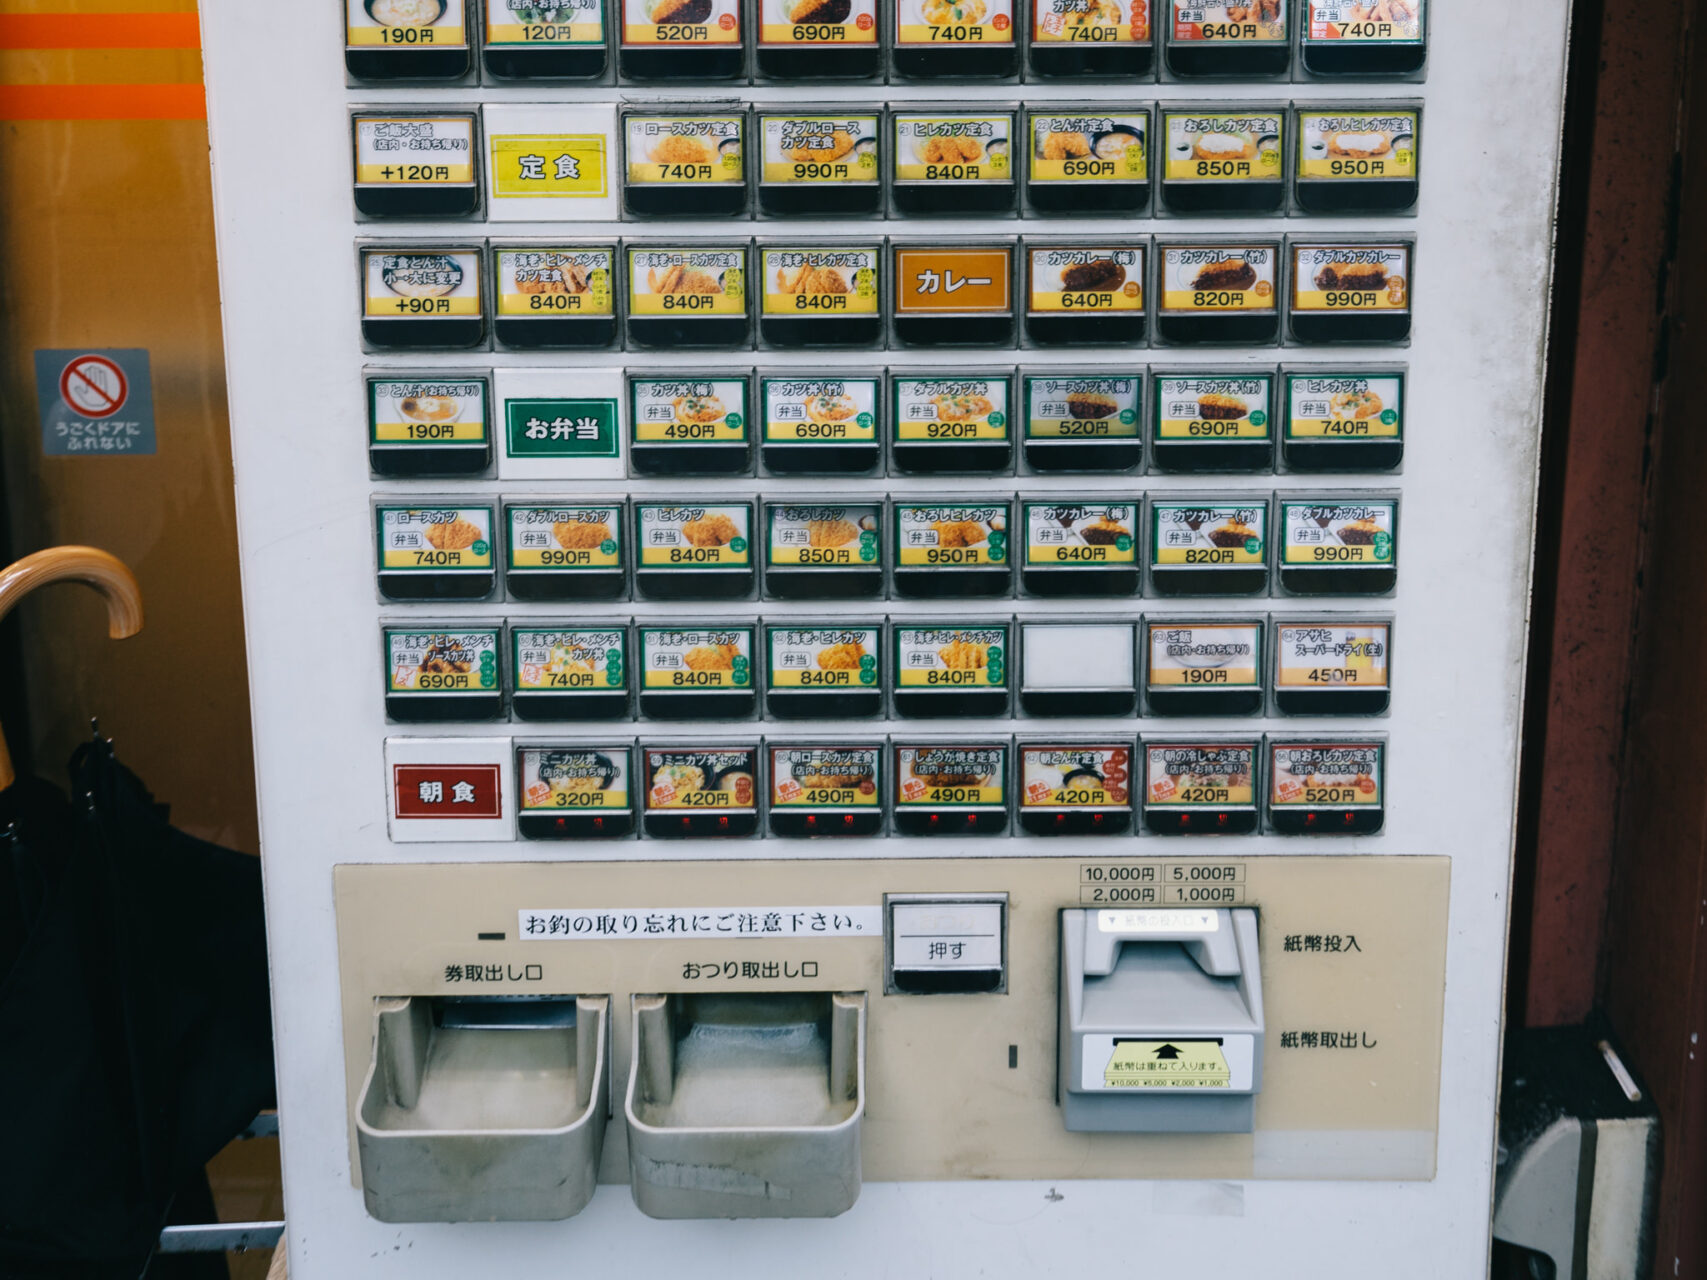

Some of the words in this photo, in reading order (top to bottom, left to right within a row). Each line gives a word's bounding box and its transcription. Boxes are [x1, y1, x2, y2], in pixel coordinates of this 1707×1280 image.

[1179, 11, 1204, 22] 弁当
[522, 26, 571, 40] 120円
[656, 26, 708, 40] 520円
[792, 27, 845, 40] 690円
[1070, 27, 1117, 41] 740円
[1202, 24, 1256, 38] 640円
[1338, 23, 1392, 38] 740円
[374, 123, 433, 138] ご飯大盛
[914, 123, 992, 137] ヒレカツ定食
[1051, 119, 1114, 132] とん汁定食
[1185, 119, 1279, 132] おろしカツ定食
[519, 154, 581, 180] 定食
[659, 164, 712, 179] 740円
[794, 164, 848, 178] 990円
[926, 165, 979, 180] 840円
[1197, 161, 1250, 176] 850円
[1331, 160, 1384, 175] 950円
[1314, 251, 1400, 263] ダブルカツカレー
[917, 270, 992, 294] カレー
[530, 295, 580, 309] 840円
[1062, 293, 1112, 307] 640円
[1326, 292, 1376, 306] 990円
[525, 417, 599, 440] お弁当
[665, 424, 715, 438] 490円
[928, 423, 977, 437] 920円
[1321, 420, 1368, 434] 740円
[68, 437, 131, 450] ふれない
[397, 511, 458, 524] ロースカツ
[914, 509, 997, 522] おろしヒレカツ
[928, 549, 978, 563] 950円
[1186, 549, 1234, 563] 820円
[1296, 630, 1332, 642] アサヒ
[419, 674, 468, 688] 690円
[915, 750, 999, 764] しょうが焼き定食
[419, 781, 475, 803] 朝食
[556, 792, 603, 806] 320円
[931, 789, 980, 802] 490円
[1306, 788, 1354, 802] 520円
[1086, 867, 1154, 883] 10,000円
[1173, 867, 1236, 882] 5,000円
[1093, 888, 1154, 903] 2,000円
[1176, 887, 1236, 902] 1,000円
[526, 914, 863, 934] お釣の取り忘れにご注意下さい。
[929, 941, 966, 960] 押す
[1284, 935, 1362, 953] 紙幣投入
[445, 964, 543, 982] 券取出し口
[682, 960, 818, 979] おつり取出し口
[1281, 1031, 1377, 1049] 紙幣取出し
[1114, 1062, 1222, 1071] 紙幣は重ねて入ります。
